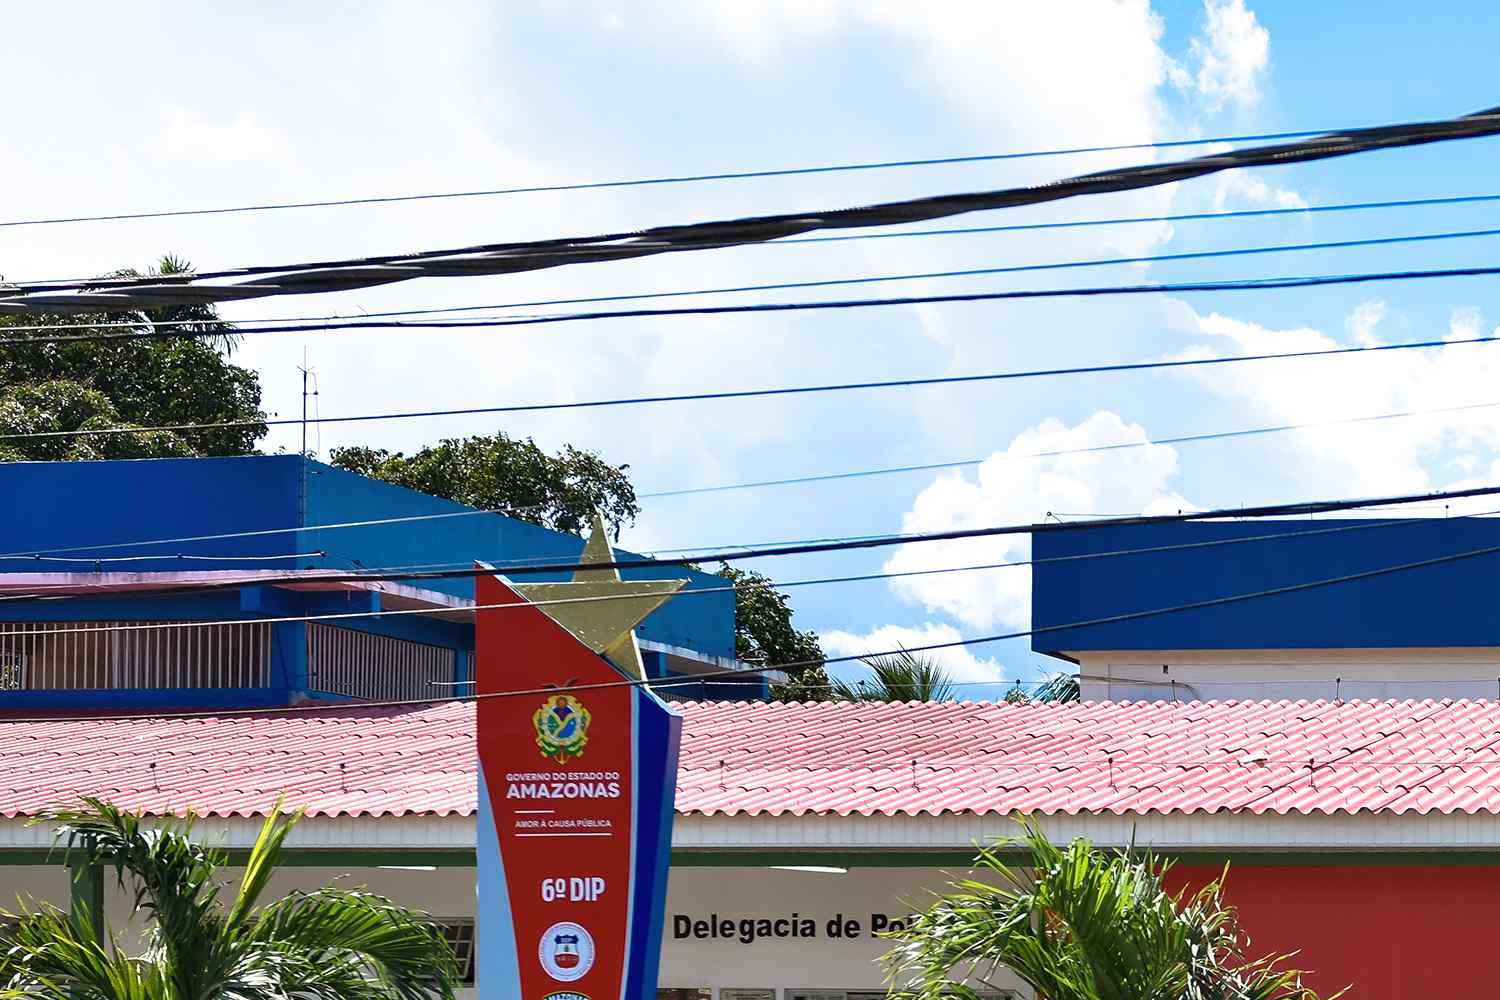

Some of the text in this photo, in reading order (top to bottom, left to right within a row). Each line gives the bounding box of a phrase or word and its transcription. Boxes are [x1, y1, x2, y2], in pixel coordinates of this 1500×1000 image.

[505, 771, 620, 781] GOVERNO DO ESTADO DO
[506, 783, 620, 799] AMAZONAS
[515, 820, 539, 828] AMOR
[548, 820, 577, 828] CAUSA
[541, 877, 606, 902] 6º DIP
[673, 913, 816, 944] Delegacia
[826, 914, 861, 938] de
